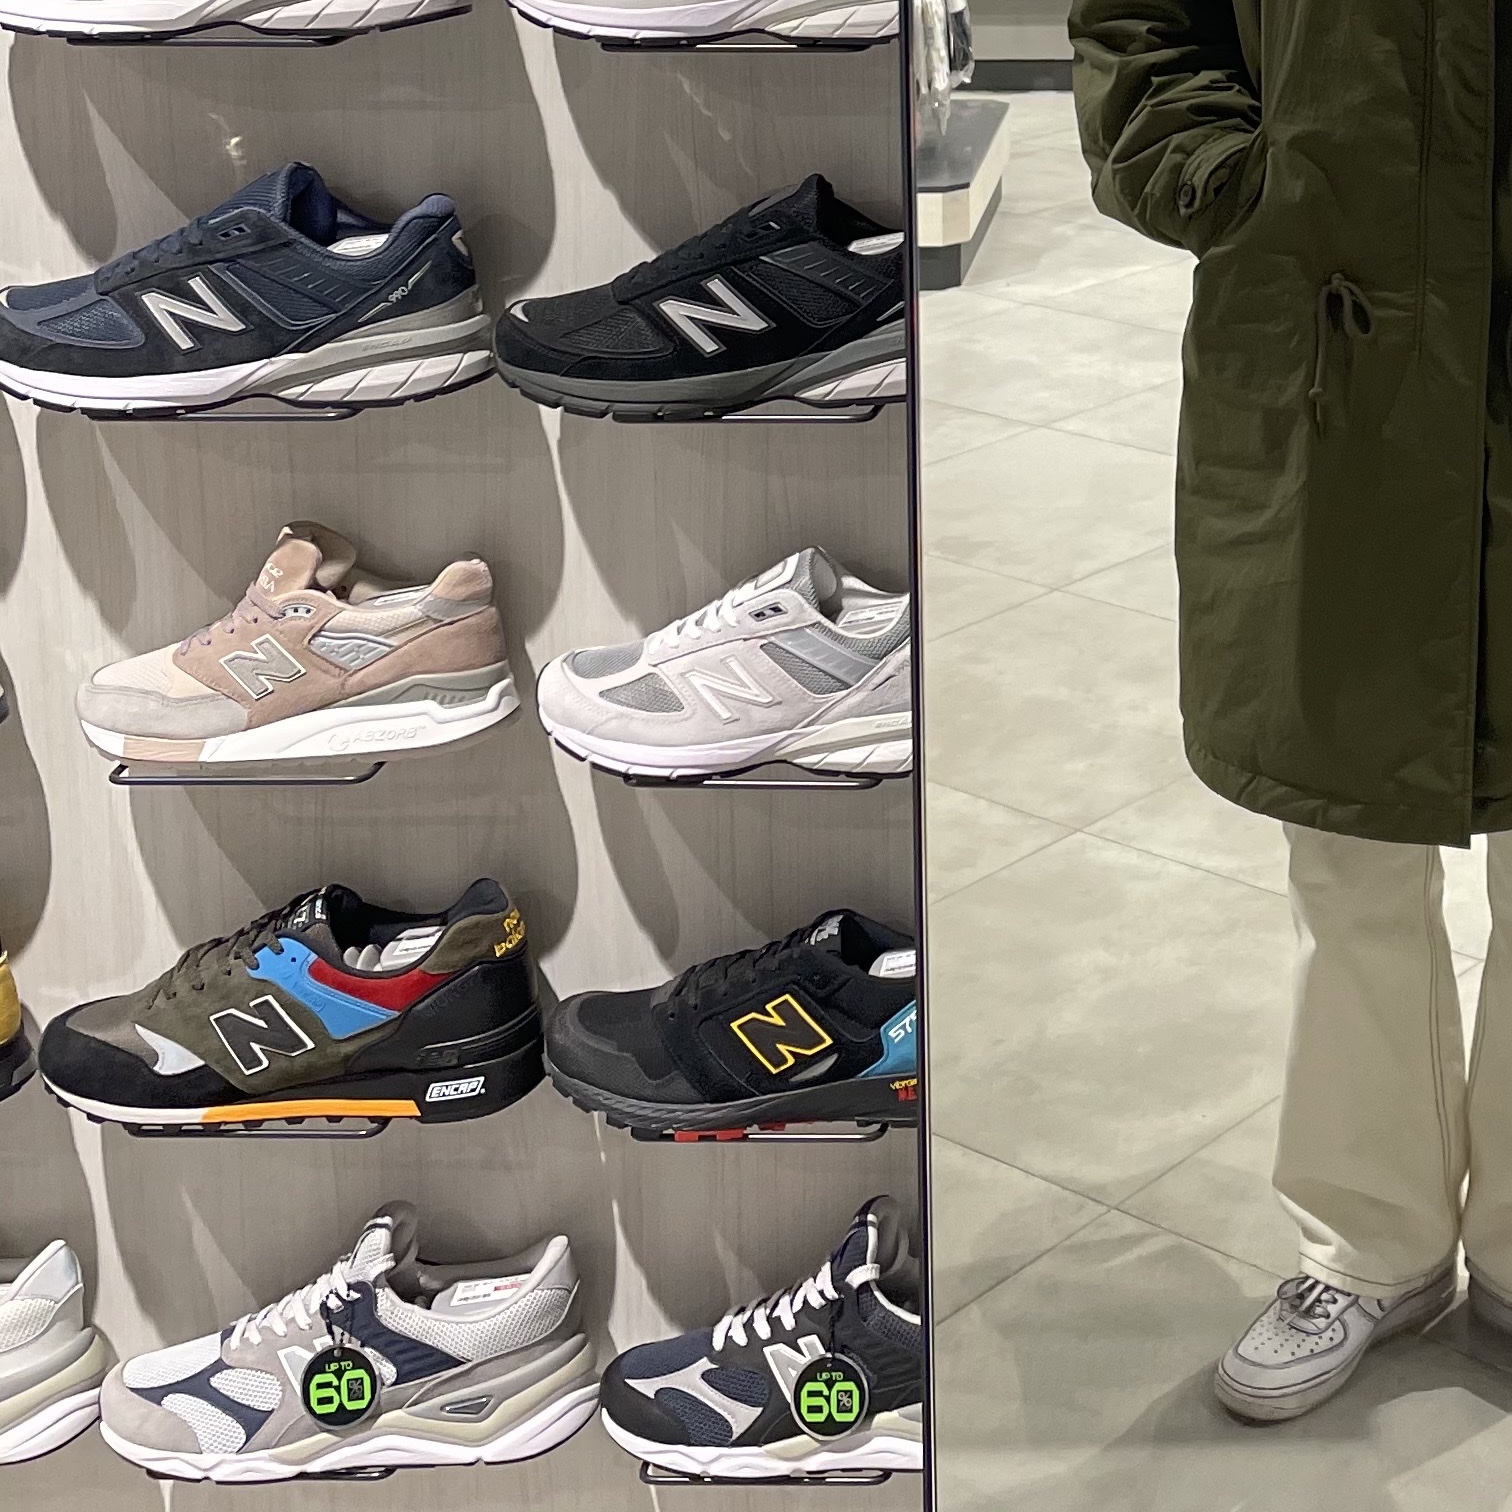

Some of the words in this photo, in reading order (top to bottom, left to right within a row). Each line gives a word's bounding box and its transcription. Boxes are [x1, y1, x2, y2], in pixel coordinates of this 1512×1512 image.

[140, 275, 246, 352] N
[659, 276, 771, 355] N
[208, 994, 316, 1075] N
[731, 994, 833, 1074] N
[428, 1078, 480, 1099] ENCAP
[325, 1361, 338, 1373] UP
[340, 1360, 353, 1371] TO
[816, 1372, 830, 1381] UP
[832, 1371, 844, 1380] TO
